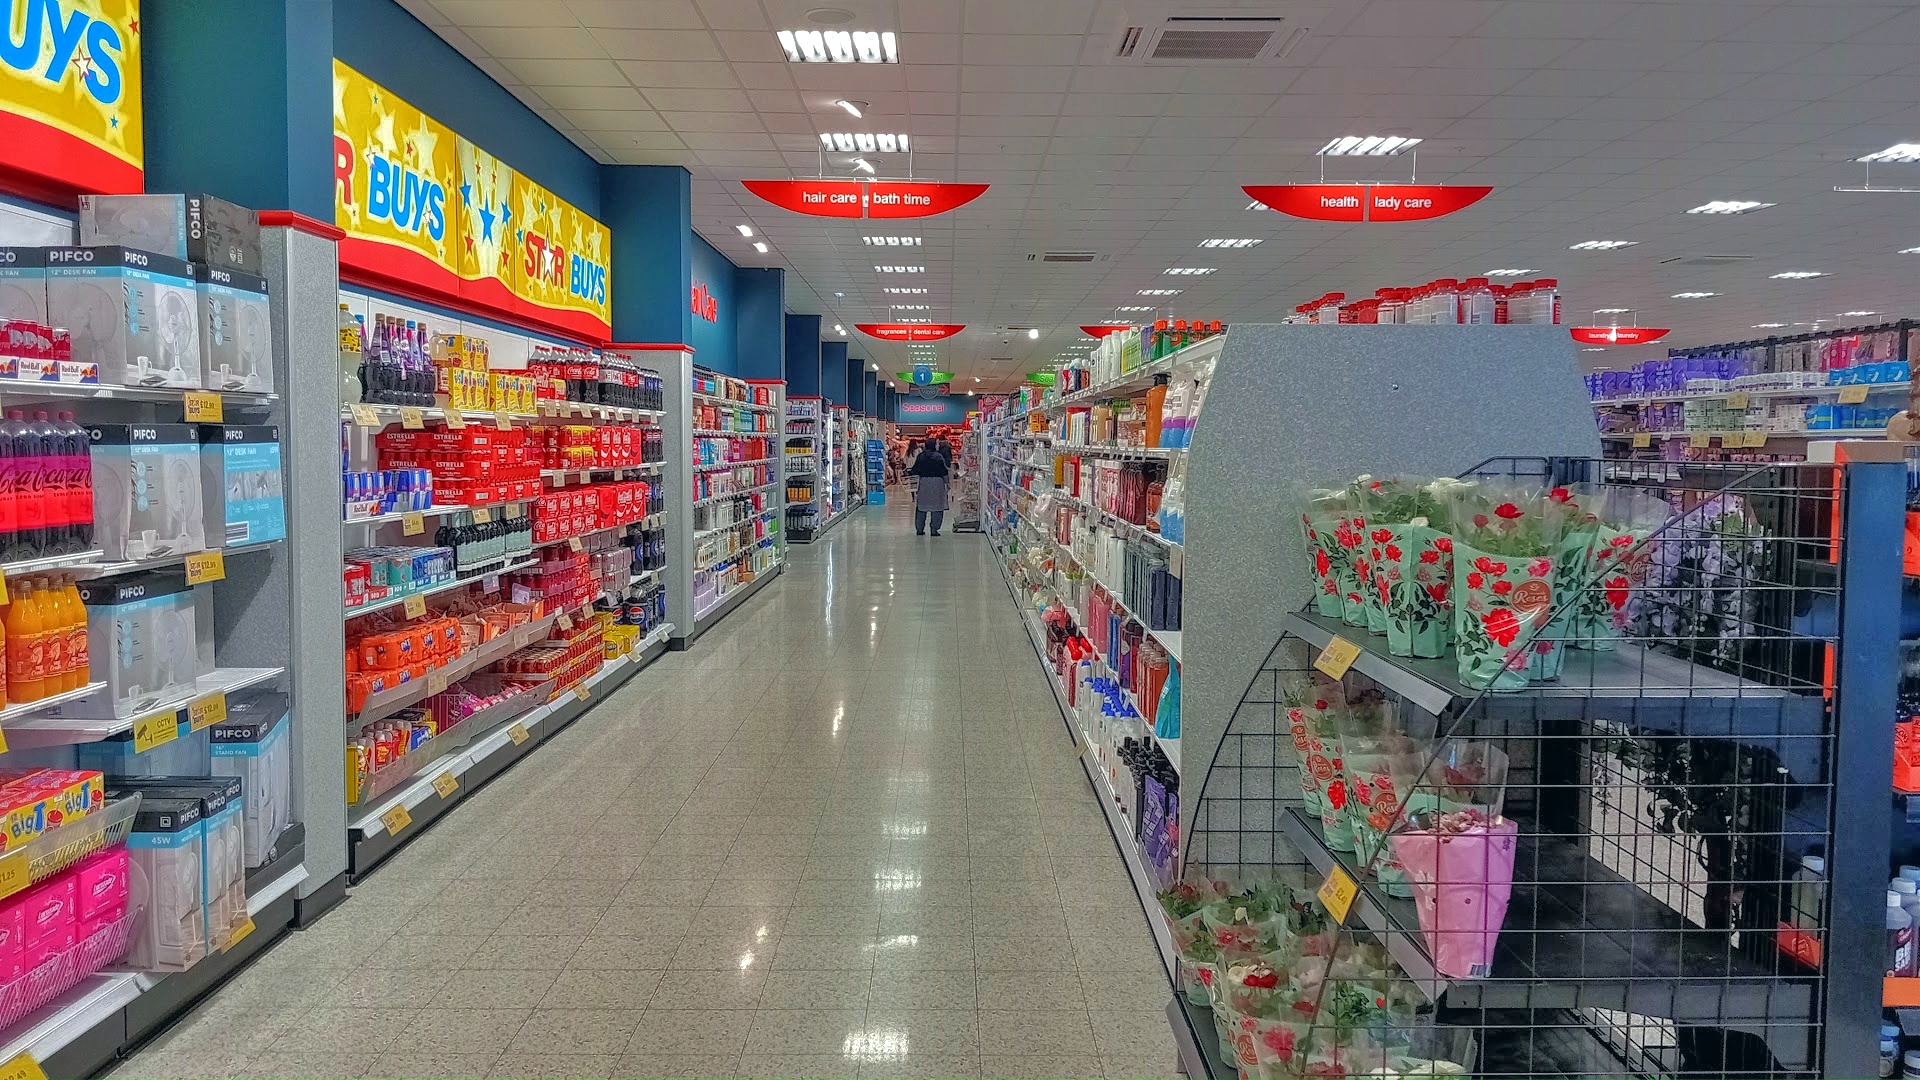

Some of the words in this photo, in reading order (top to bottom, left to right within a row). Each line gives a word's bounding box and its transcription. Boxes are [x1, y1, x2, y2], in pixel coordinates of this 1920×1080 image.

[0, 0, 121, 105] UYS
[368, 155, 446, 241] BUYS
[803, 191, 827, 203] hair
[830, 193, 857, 203] care
[873, 192, 900, 204] bath
[904, 193, 931, 205] time
[1320, 196, 1359, 207] health
[1374, 196, 1400, 211] lady
[1404, 198, 1432, 208] care
[189, 199, 202, 240] PIFCO
[49, 250, 94, 262] PIFCO
[124, 251, 148, 267] PIFCO
[525, 230, 565, 289] STAR
[571, 253, 606, 305] BUYS
[211, 270, 231, 283] PIFCO
[902, 403, 944, 412] Seasonal
[133, 430, 157, 440] PIFCO
[225, 430, 244, 440] PIFCO
[120, 585, 145, 600] PIFCO
[156, 717, 171, 728] CCTV
[215, 729, 251, 739] PIFCO
[180, 807, 199, 824] PIFCO
